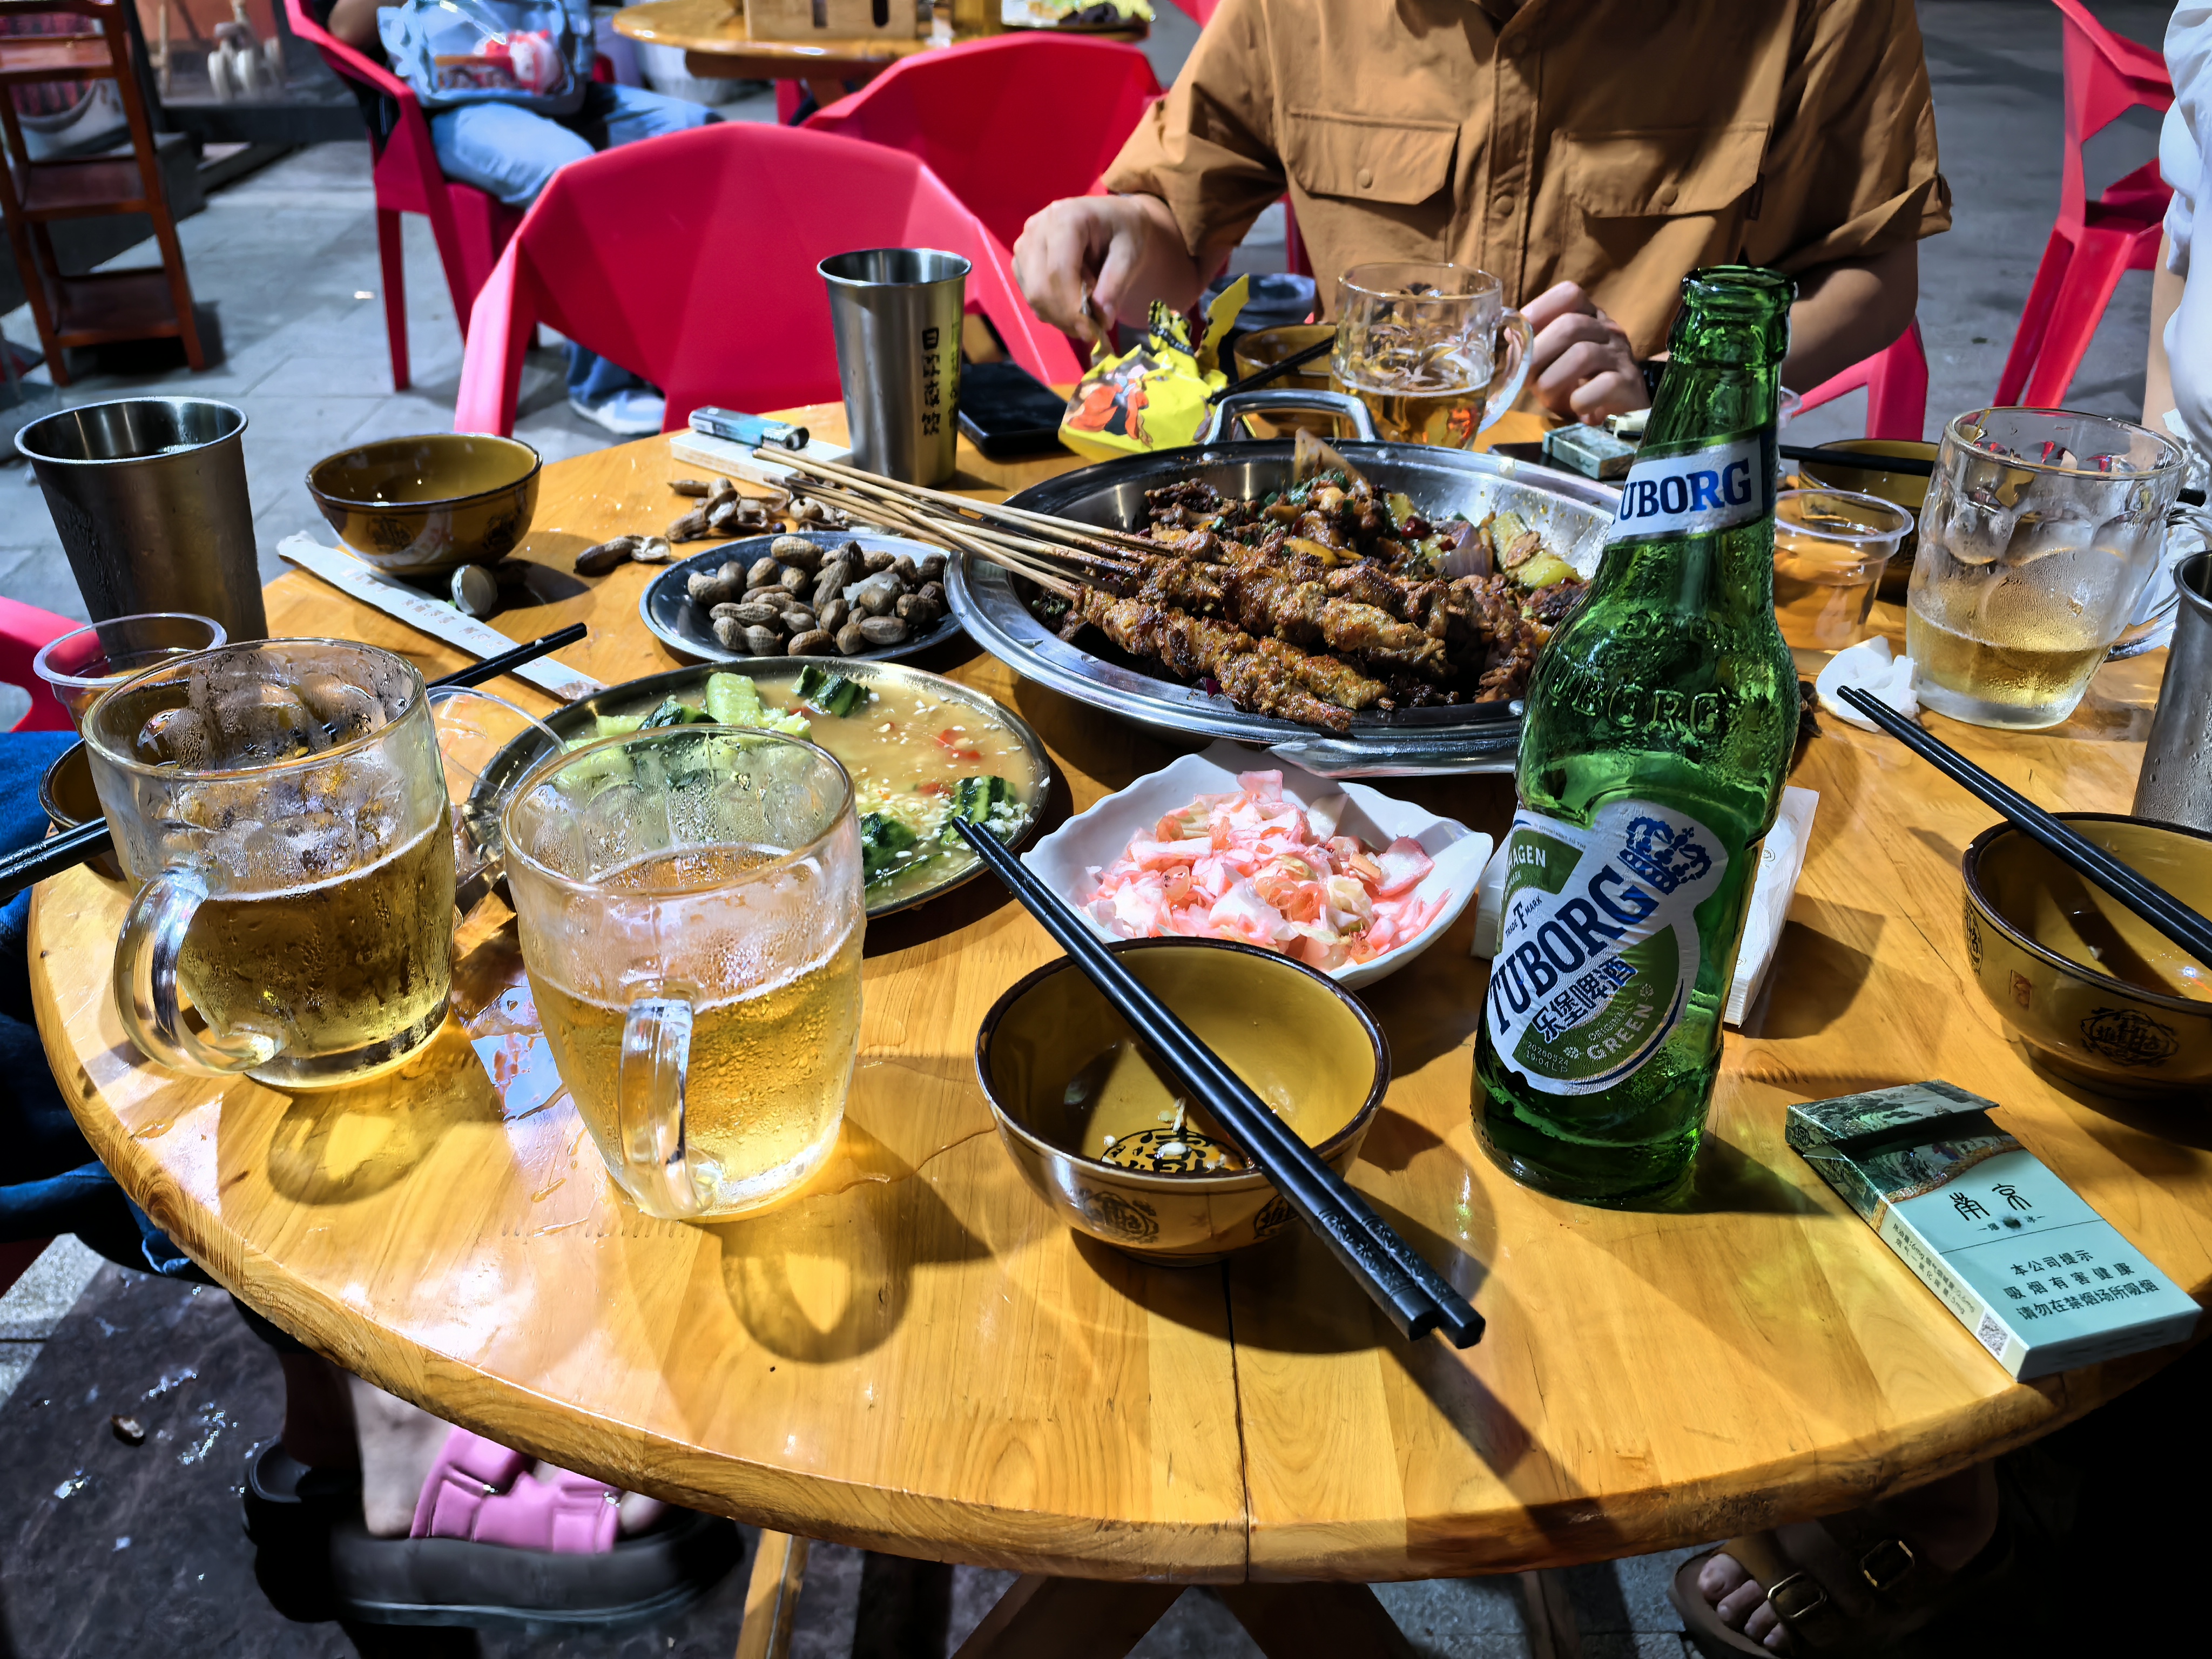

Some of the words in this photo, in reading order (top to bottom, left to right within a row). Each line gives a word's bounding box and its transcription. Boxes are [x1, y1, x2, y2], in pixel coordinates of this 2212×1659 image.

[1612, 458, 1751, 525] UBORG
[1505, 918, 1519, 939] TRADE
[1525, 894, 1542, 916] MARK
[1490, 864, 1660, 1035] TUBORG
[1532, 955, 1638, 1044] 乐堡啤酒
[1586, 1003, 1654, 1060] GREEN
[2003, 1262, 2135, 1300] 吸烟有害健康
[2010, 1250, 2094, 1276] 本公司提示
[2015, 1279, 2160, 1320] 请勿在禁烟场所吸烟
